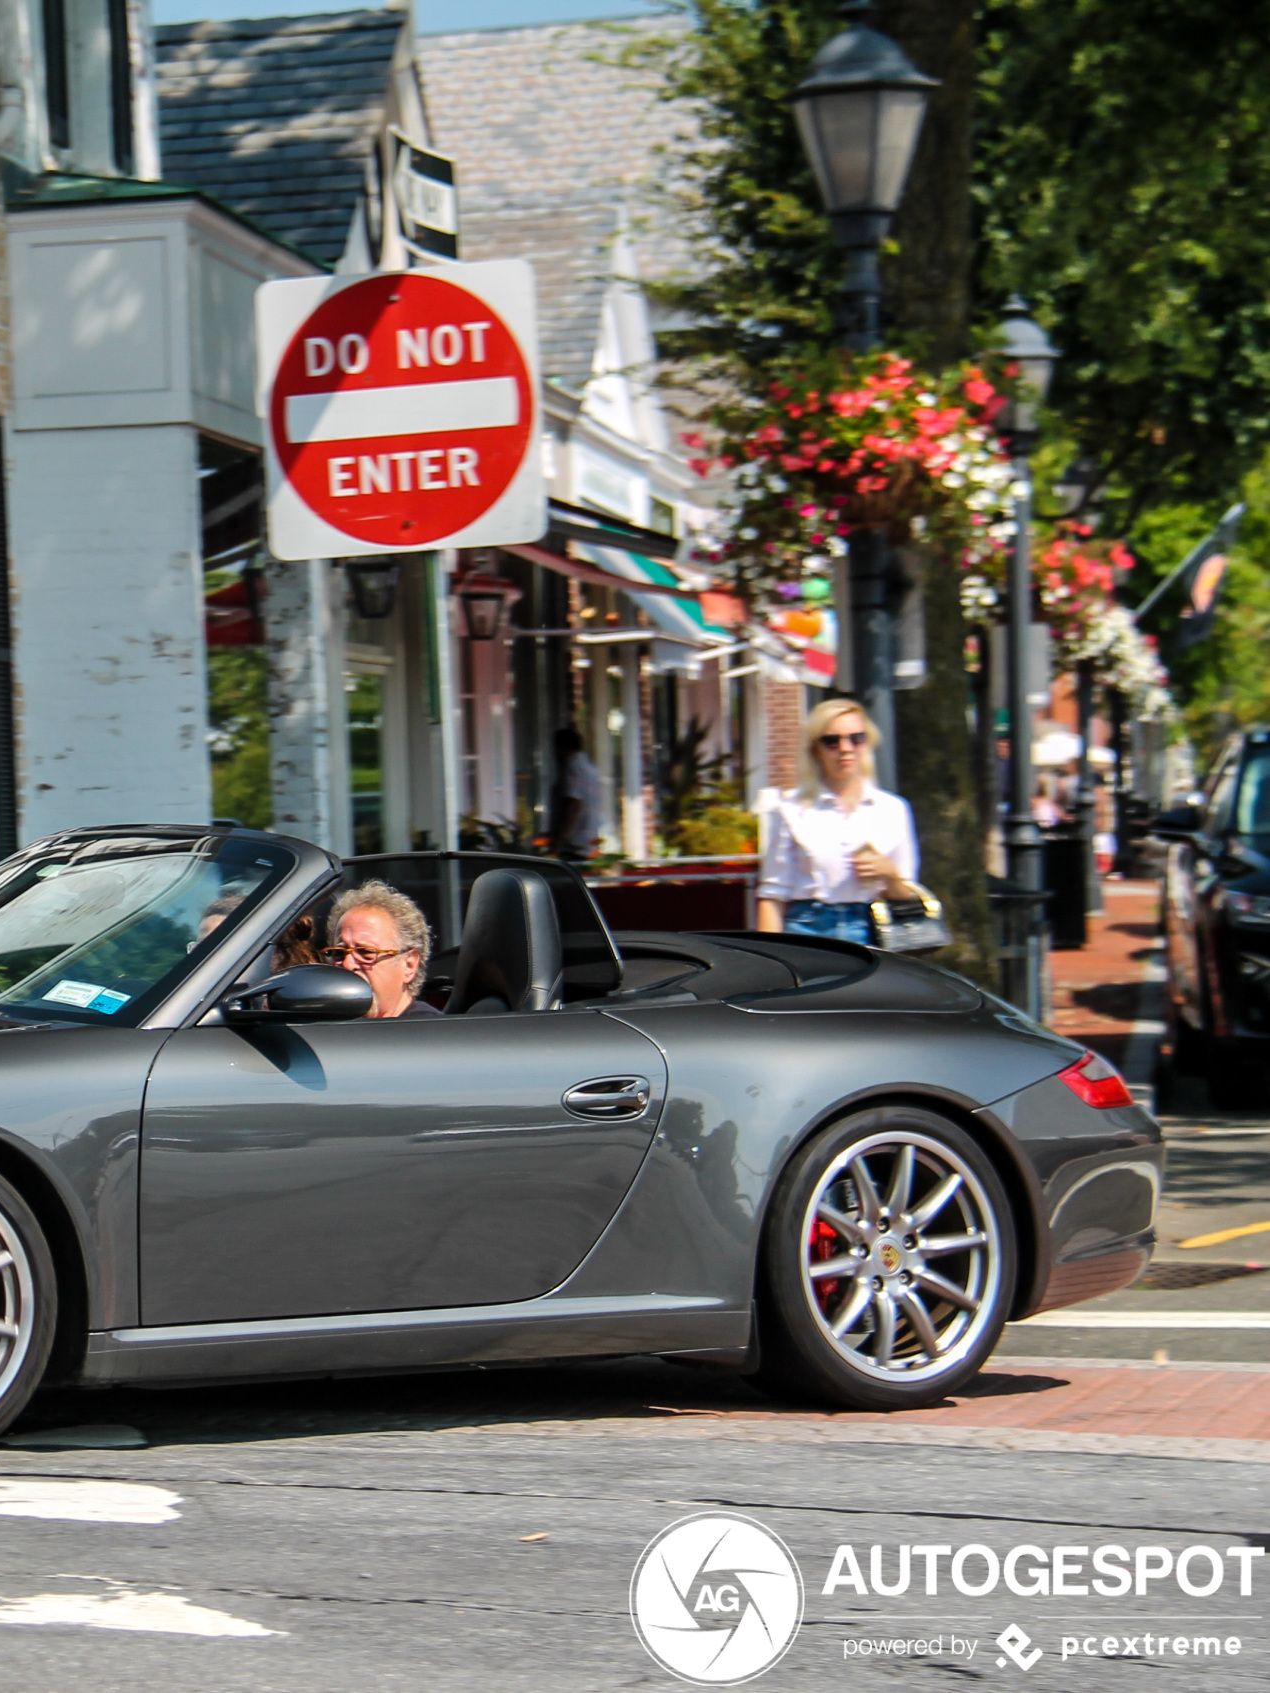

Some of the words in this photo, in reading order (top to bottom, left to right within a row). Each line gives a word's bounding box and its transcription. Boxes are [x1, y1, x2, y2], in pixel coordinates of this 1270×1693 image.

[304, 333, 370, 377] DO
[396, 322, 491, 369] NOT
[328, 446, 480, 497] ENTER
